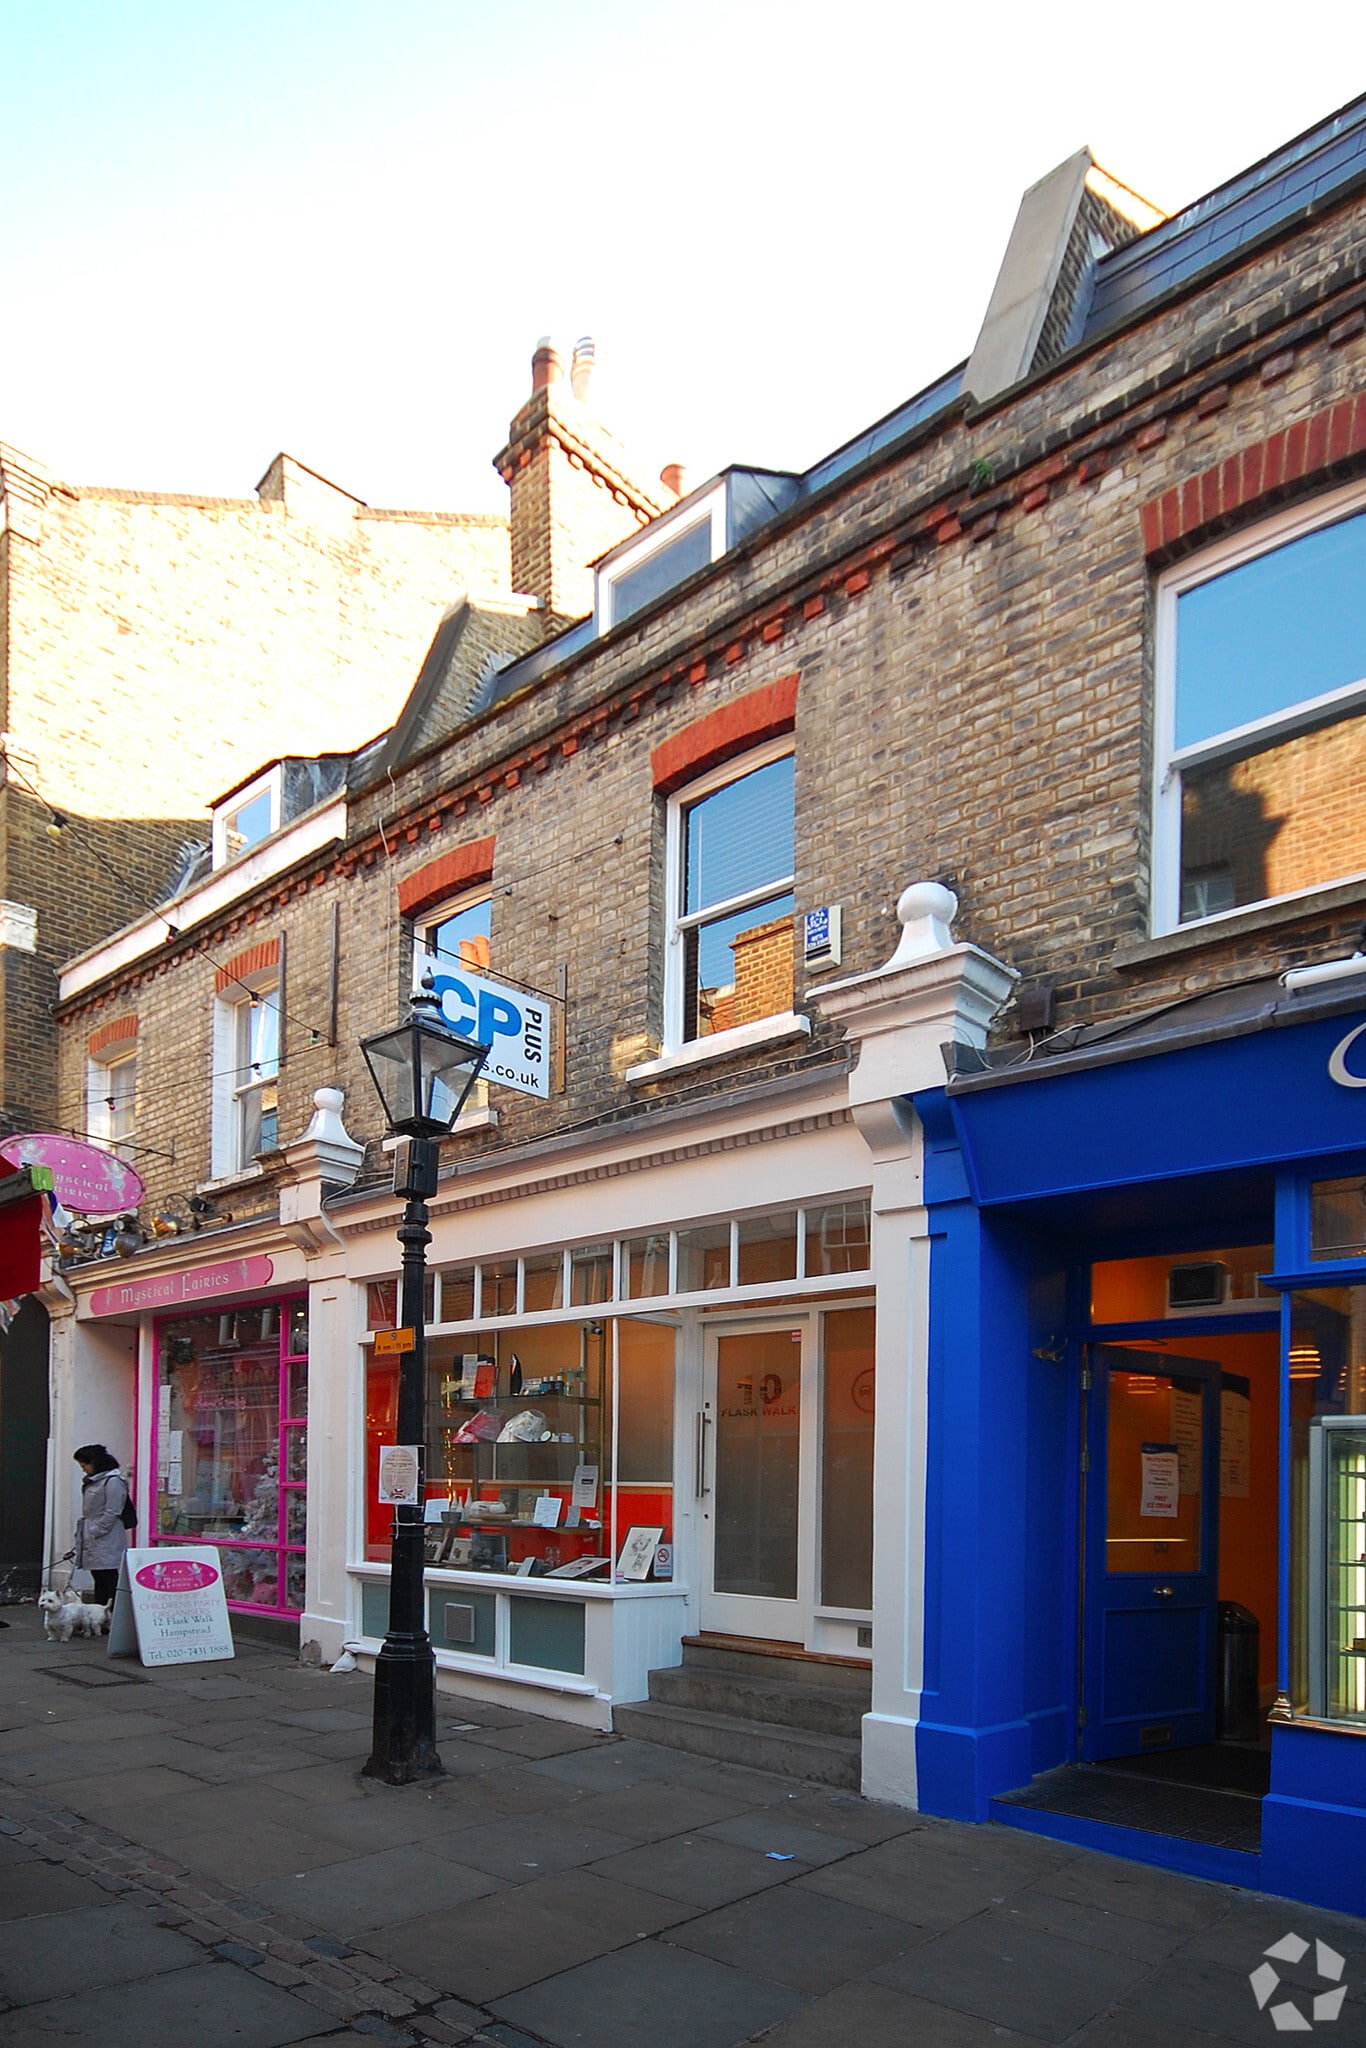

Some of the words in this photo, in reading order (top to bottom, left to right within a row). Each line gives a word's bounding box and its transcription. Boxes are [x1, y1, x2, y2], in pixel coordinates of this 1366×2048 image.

[433, 974, 522, 1048] CP
[524, 1007, 543, 1064] PLUS
[473, 1059, 540, 1089] s.co.uk
[54, 1185, 100, 1202] airies
[55, 1173, 109, 1193] ystical
[120, 1280, 176, 1306] Mystical
[180, 1272, 230, 1299] Fairies
[736, 1373, 783, 1406] 10
[721, 1406, 759, 1418] FLASK
[762, 1405, 797, 1417] WALK
[153, 1618, 163, 1627] 12
[166, 1616, 190, 1626] Flask
[191, 1614, 213, 1624] Walk
[160, 1625, 211, 1638] Hampstead
